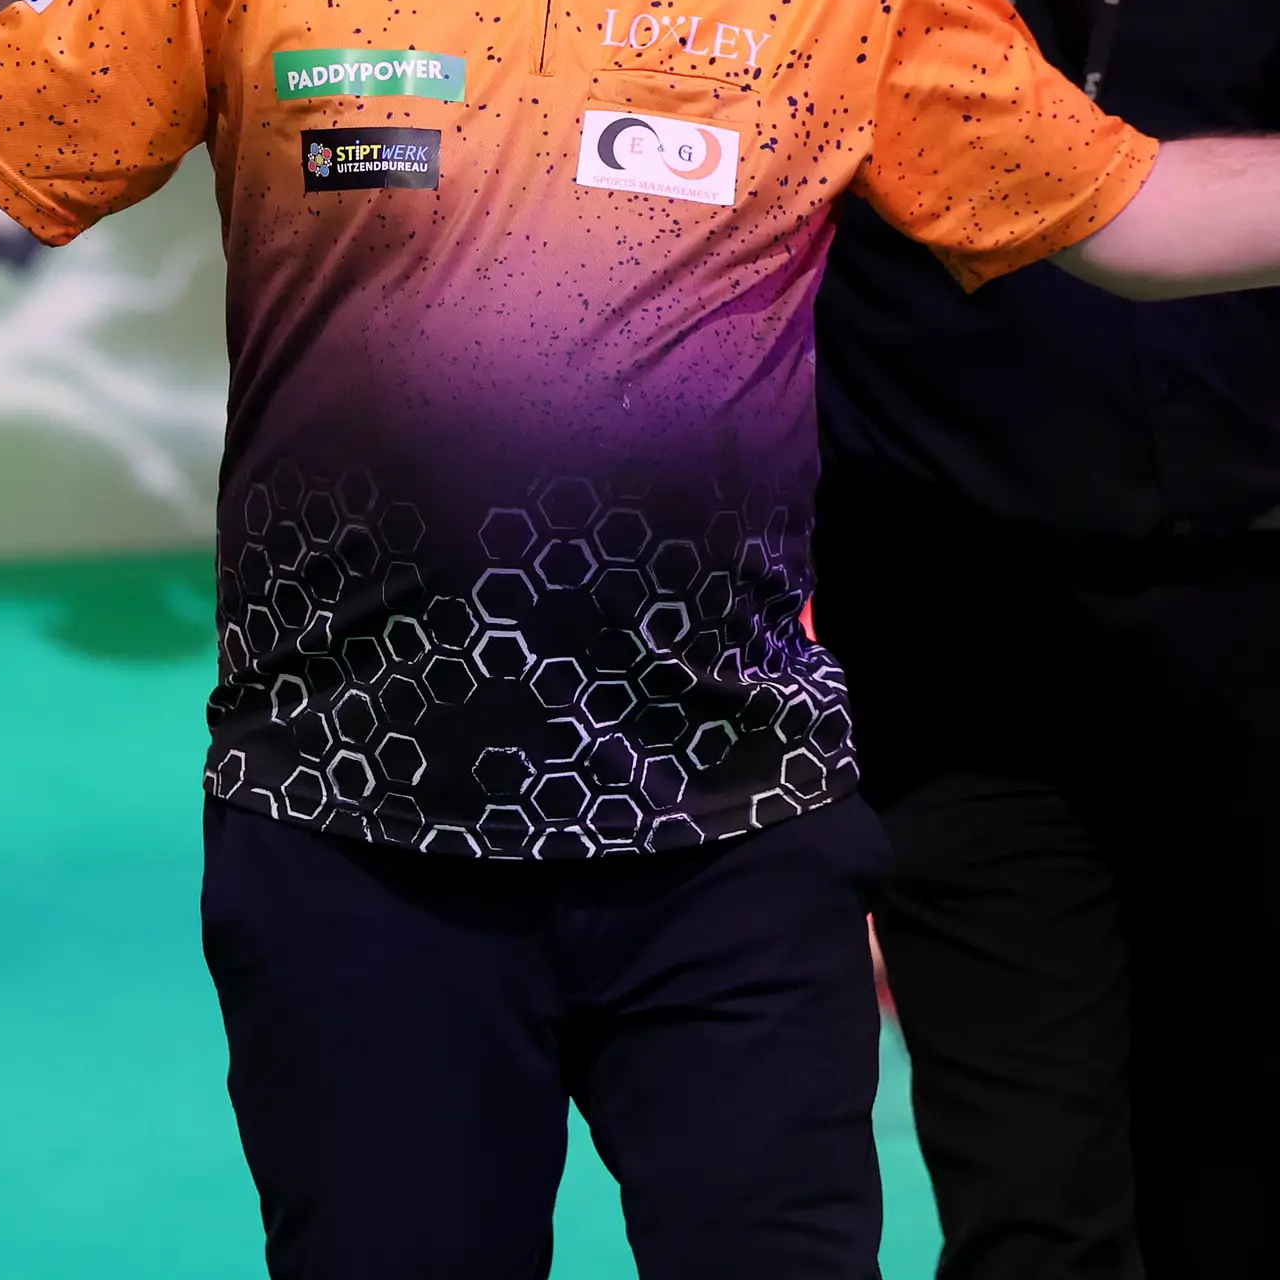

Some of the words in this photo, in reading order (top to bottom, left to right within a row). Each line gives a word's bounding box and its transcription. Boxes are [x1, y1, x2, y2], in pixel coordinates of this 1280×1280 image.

[337, 160, 429, 174] UITZENDBUREAU
[592, 175, 637, 188] SPORTS
[638, 180, 719, 201] MANAGEMENT
